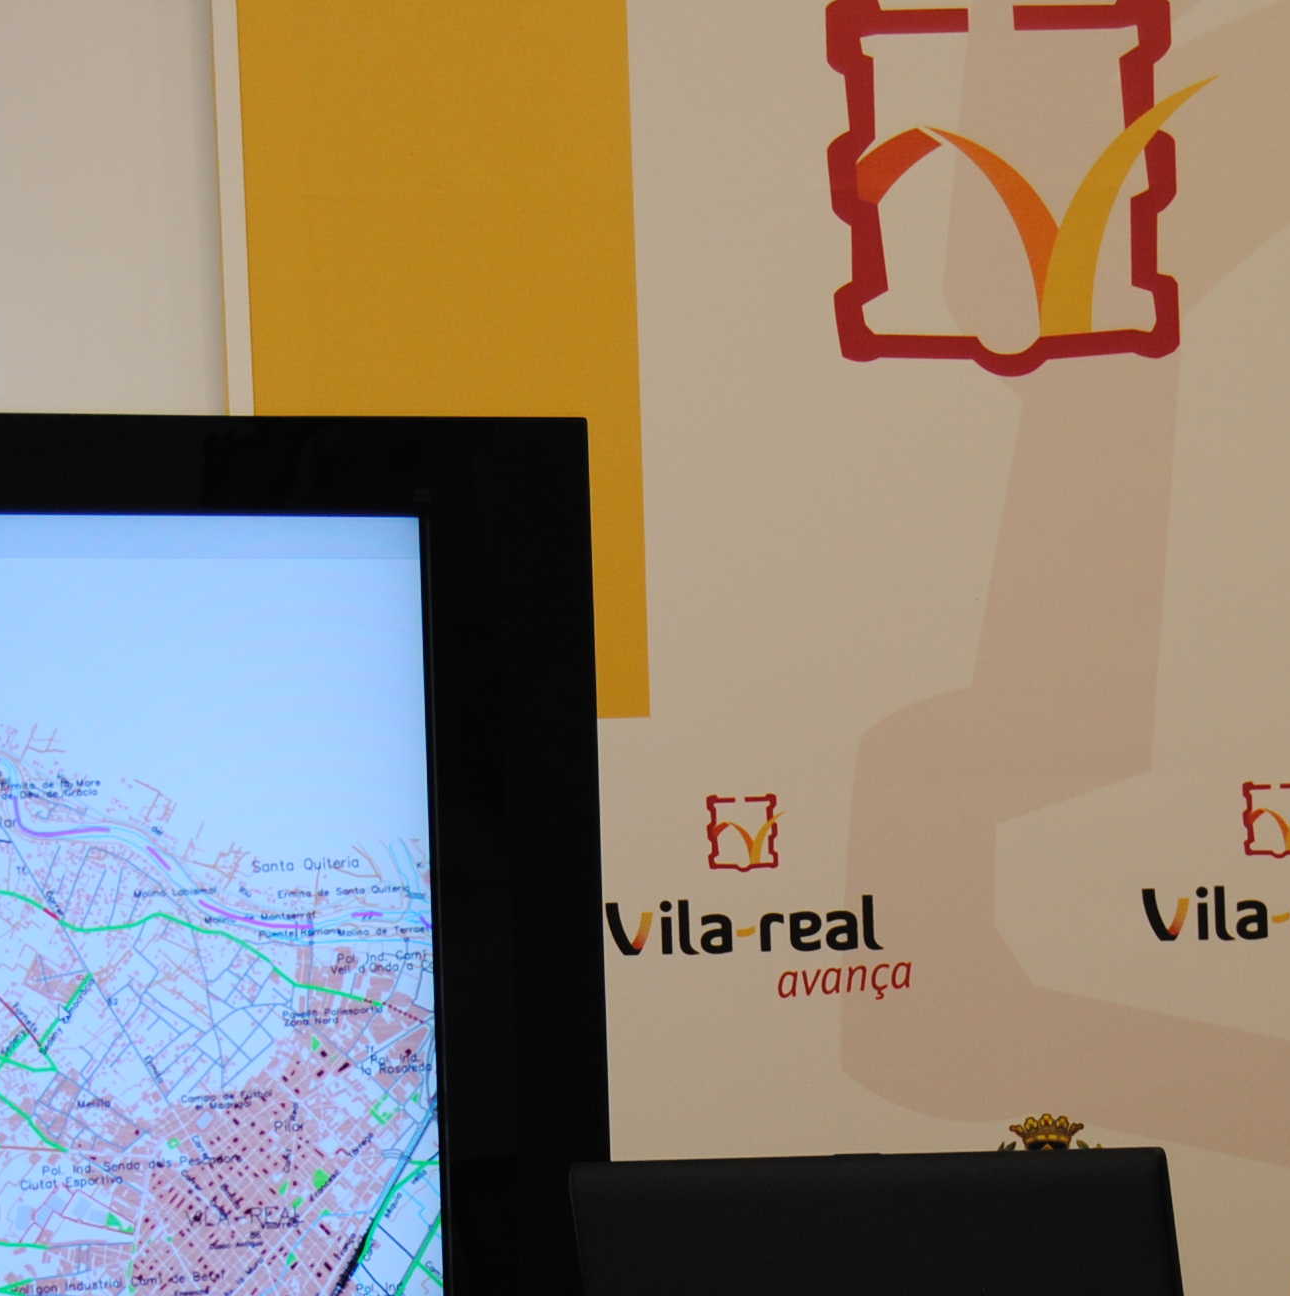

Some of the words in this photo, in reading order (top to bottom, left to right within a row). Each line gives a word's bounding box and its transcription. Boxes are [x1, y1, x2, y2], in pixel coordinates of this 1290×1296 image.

[252, 859, 295, 873] Santa
[605, 894, 884, 956] Vila-real
[776, 961, 913, 1000] avança
